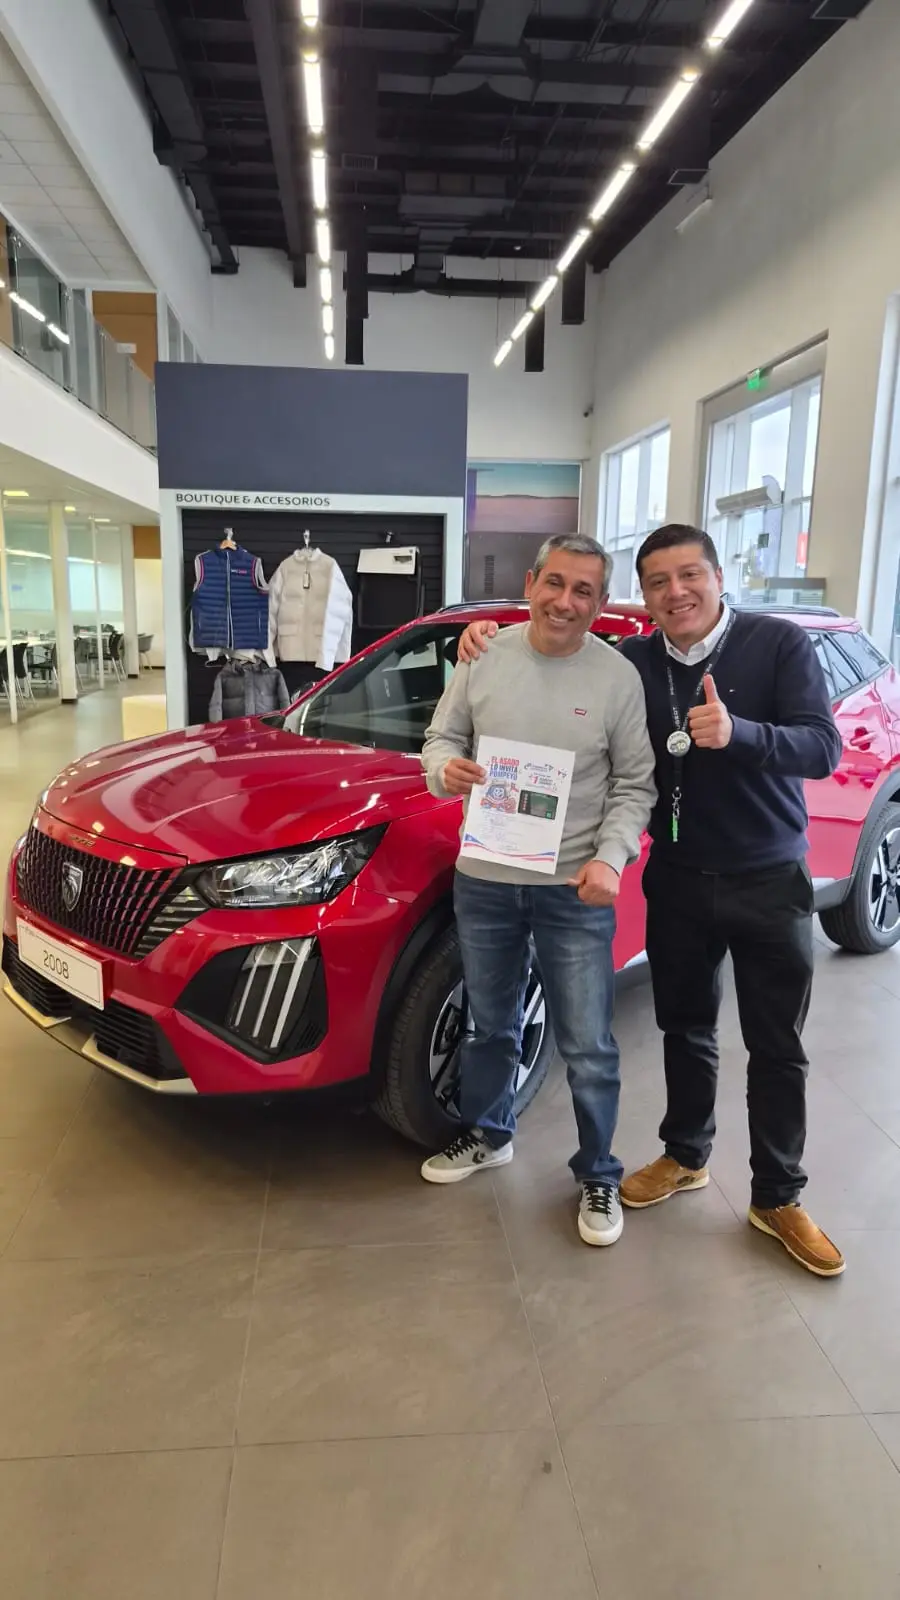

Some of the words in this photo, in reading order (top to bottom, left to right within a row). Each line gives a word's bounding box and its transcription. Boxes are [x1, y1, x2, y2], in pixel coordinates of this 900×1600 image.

[176, 493, 241, 505] BOUTIQUE
[242, 495, 250, 504] &
[253, 495, 331, 507] ACCESORIOS
[500, 765, 518, 773] INVITA
[489, 770, 518, 781] POMPEYO
[43, 950, 69, 980] 2008
